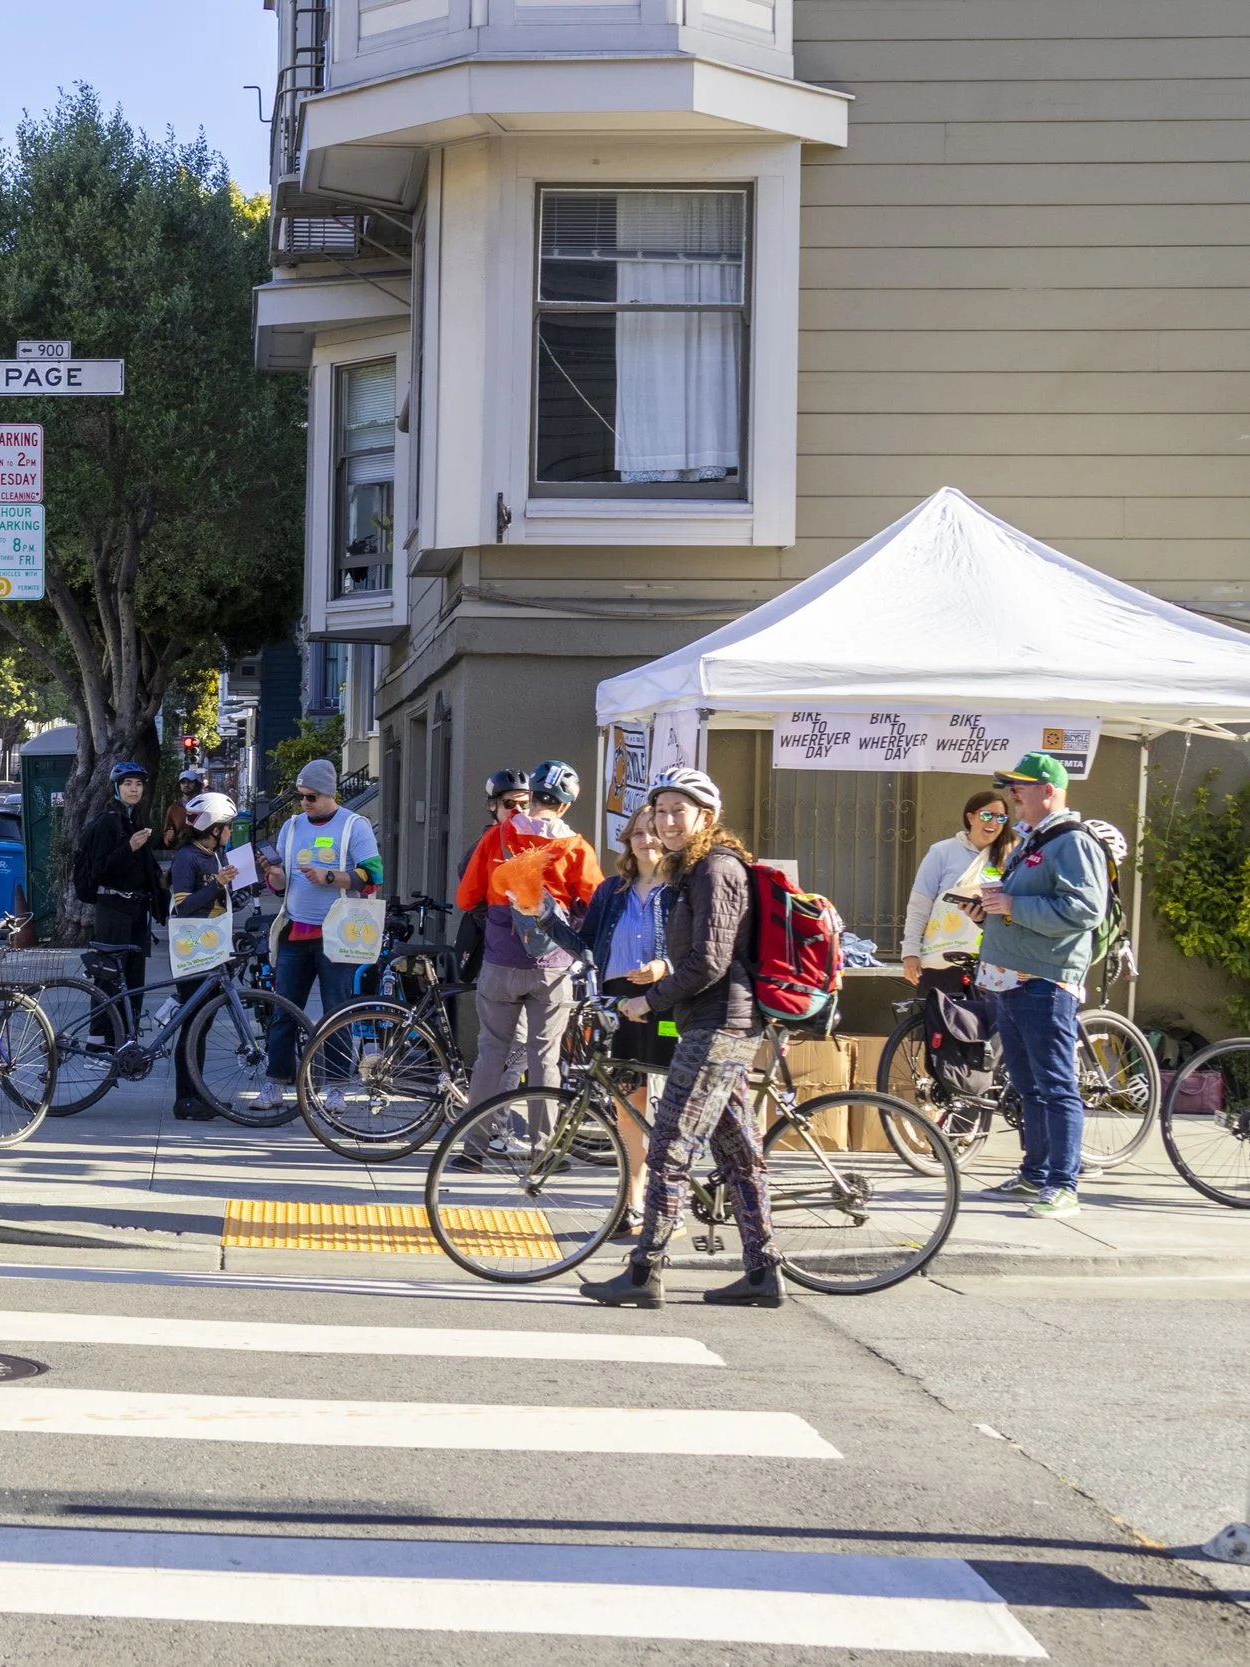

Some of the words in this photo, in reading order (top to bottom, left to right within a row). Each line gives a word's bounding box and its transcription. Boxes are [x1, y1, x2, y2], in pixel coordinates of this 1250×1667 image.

[38, 344, 64, 356] 900
[5, 368, 82, 386] PAGE
[1, 492, 36, 500] CLEANING
[1, 508, 31, 517] HOUR
[19, 556, 35, 565] FRI
[792, 712, 822, 722] BIKE
[870, 713, 901, 724] BIKE
[950, 715, 982, 727] BIKE
[812, 722, 827, 734] TO
[890, 723, 906, 735] TO
[970, 726, 985, 738] TO
[780, 732, 851, 748] WHEREVER
[858, 733, 928, 750] WHEREVER
[936, 738, 1009, 751] WHEREVER
[806, 746, 831, 758] DAY
[884, 747, 911, 760] DAY
[961, 750, 990, 763] DAY
[1059, 760, 1084, 768] FMTA
